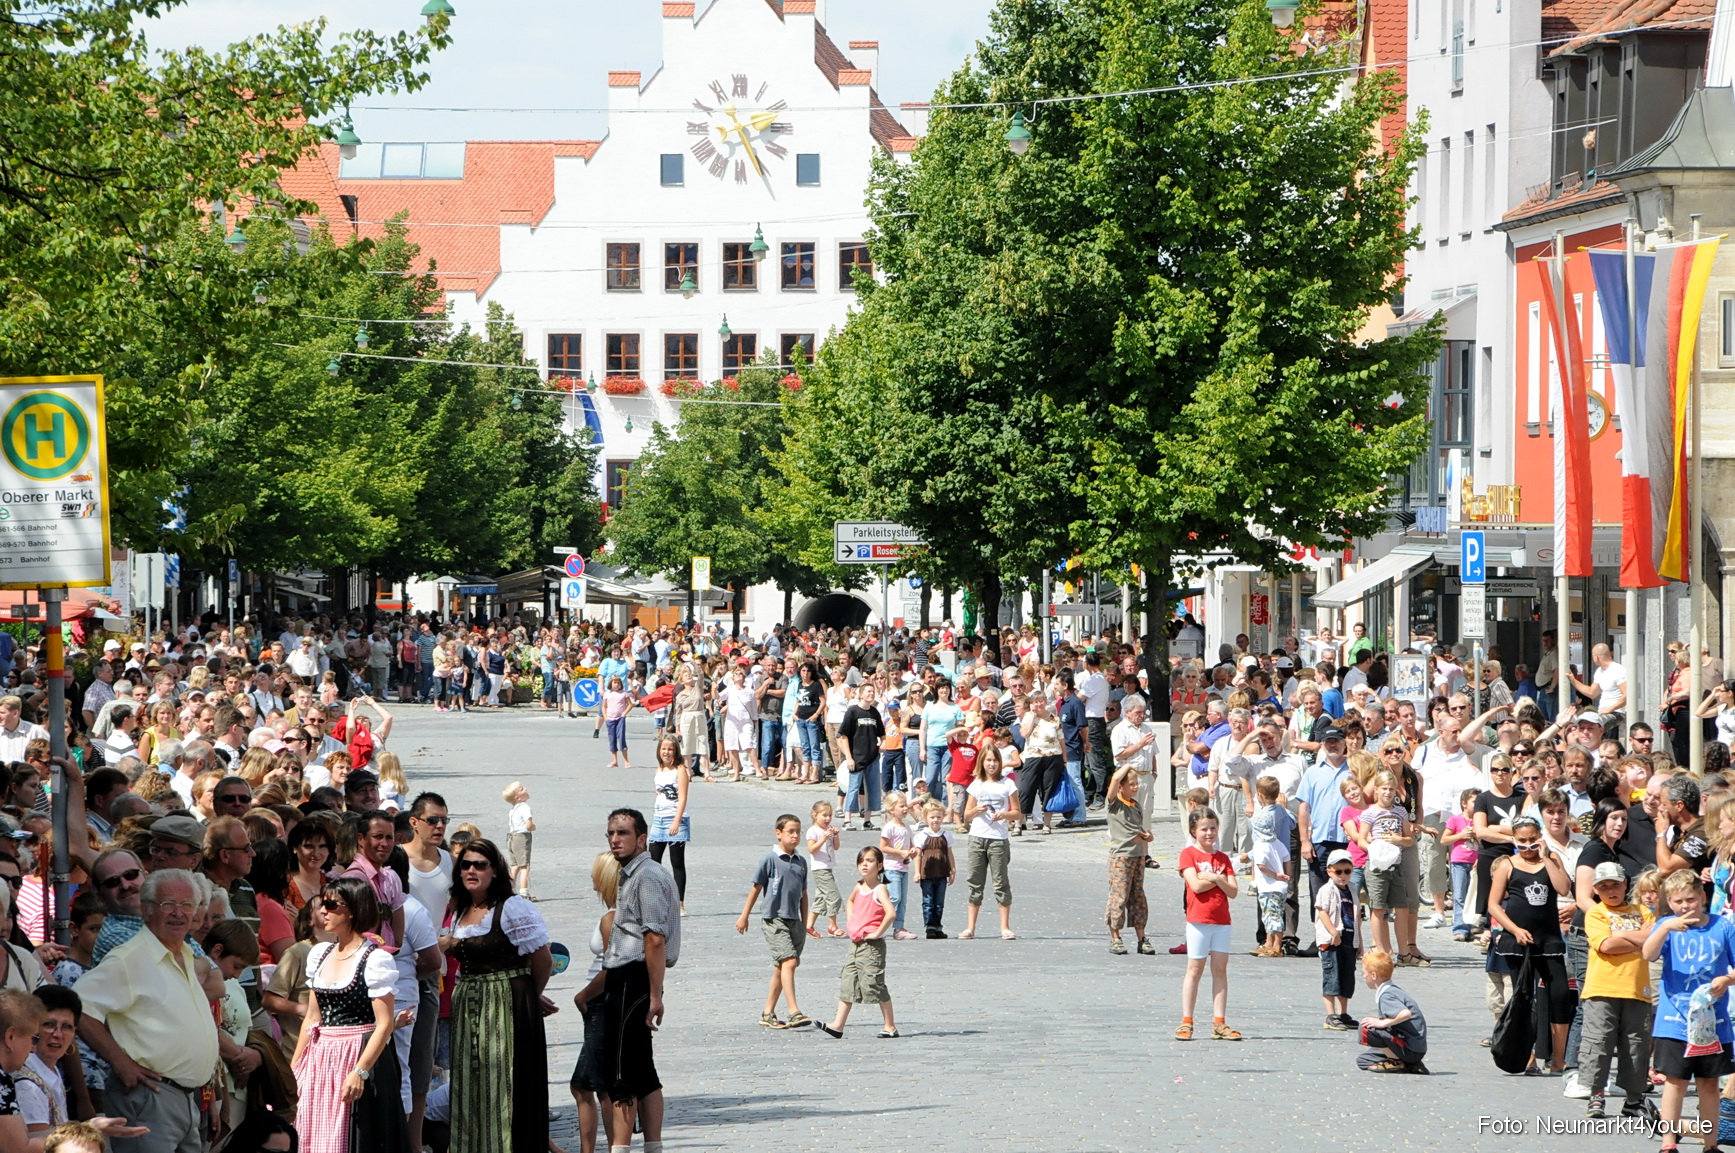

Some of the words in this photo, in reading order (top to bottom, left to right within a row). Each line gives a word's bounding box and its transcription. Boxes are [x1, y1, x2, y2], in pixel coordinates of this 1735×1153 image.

[24, 412, 66, 459] H
[2, 492, 49, 503] Oberer
[55, 489, 93, 501] Markt
[1466, 538, 1479, 576] P
